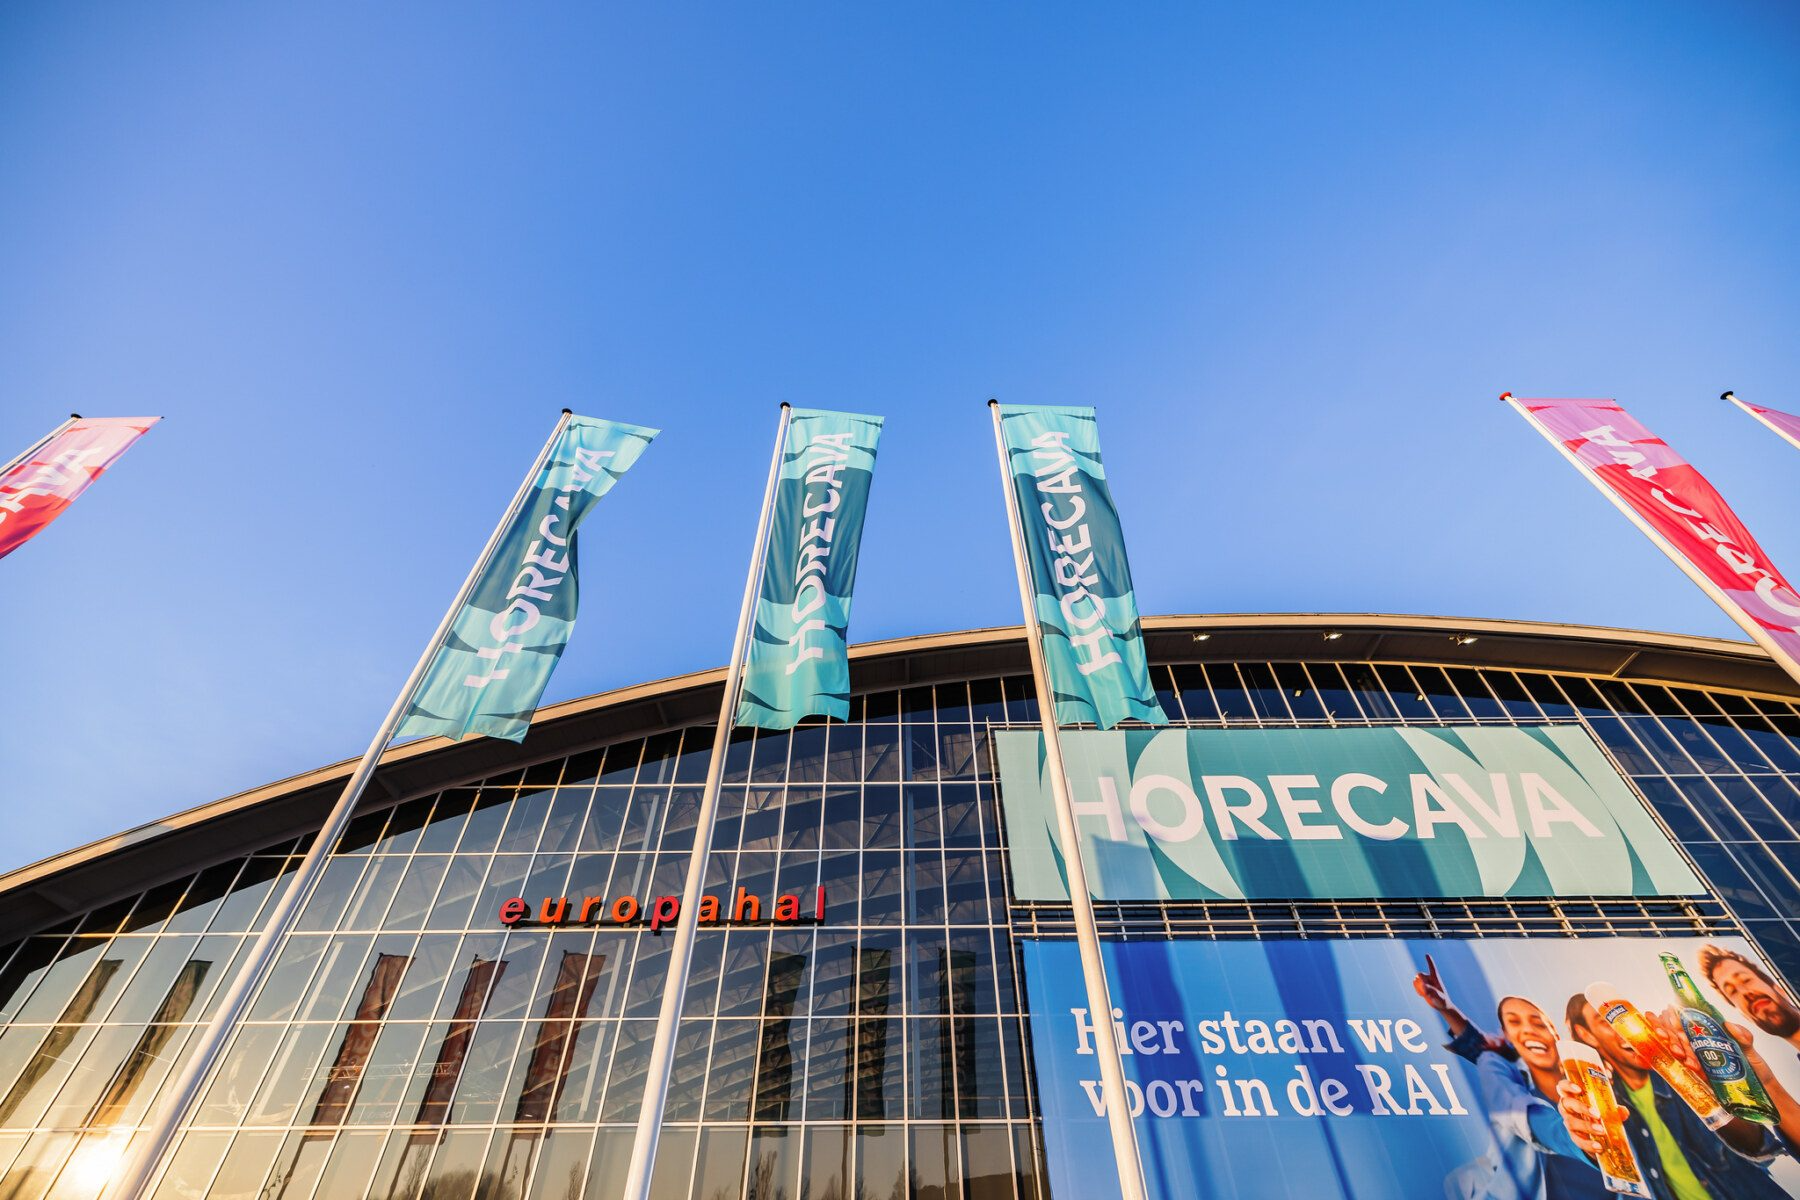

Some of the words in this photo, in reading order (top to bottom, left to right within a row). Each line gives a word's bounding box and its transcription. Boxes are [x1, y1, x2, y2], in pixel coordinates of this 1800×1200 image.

[786, 432, 853, 676] HORECAVA
[1031, 431, 1123, 675] HORECAVA
[1066, 772, 1604, 843] HORECAVA
[499, 886, 825, 930] europahal
[1198, 1011, 1345, 1054] staan
[1347, 1018, 1428, 1053] we
[1215, 1064, 1278, 1116] in
[1287, 1065, 1354, 1116] de
[1355, 1064, 1469, 1115] RAI
